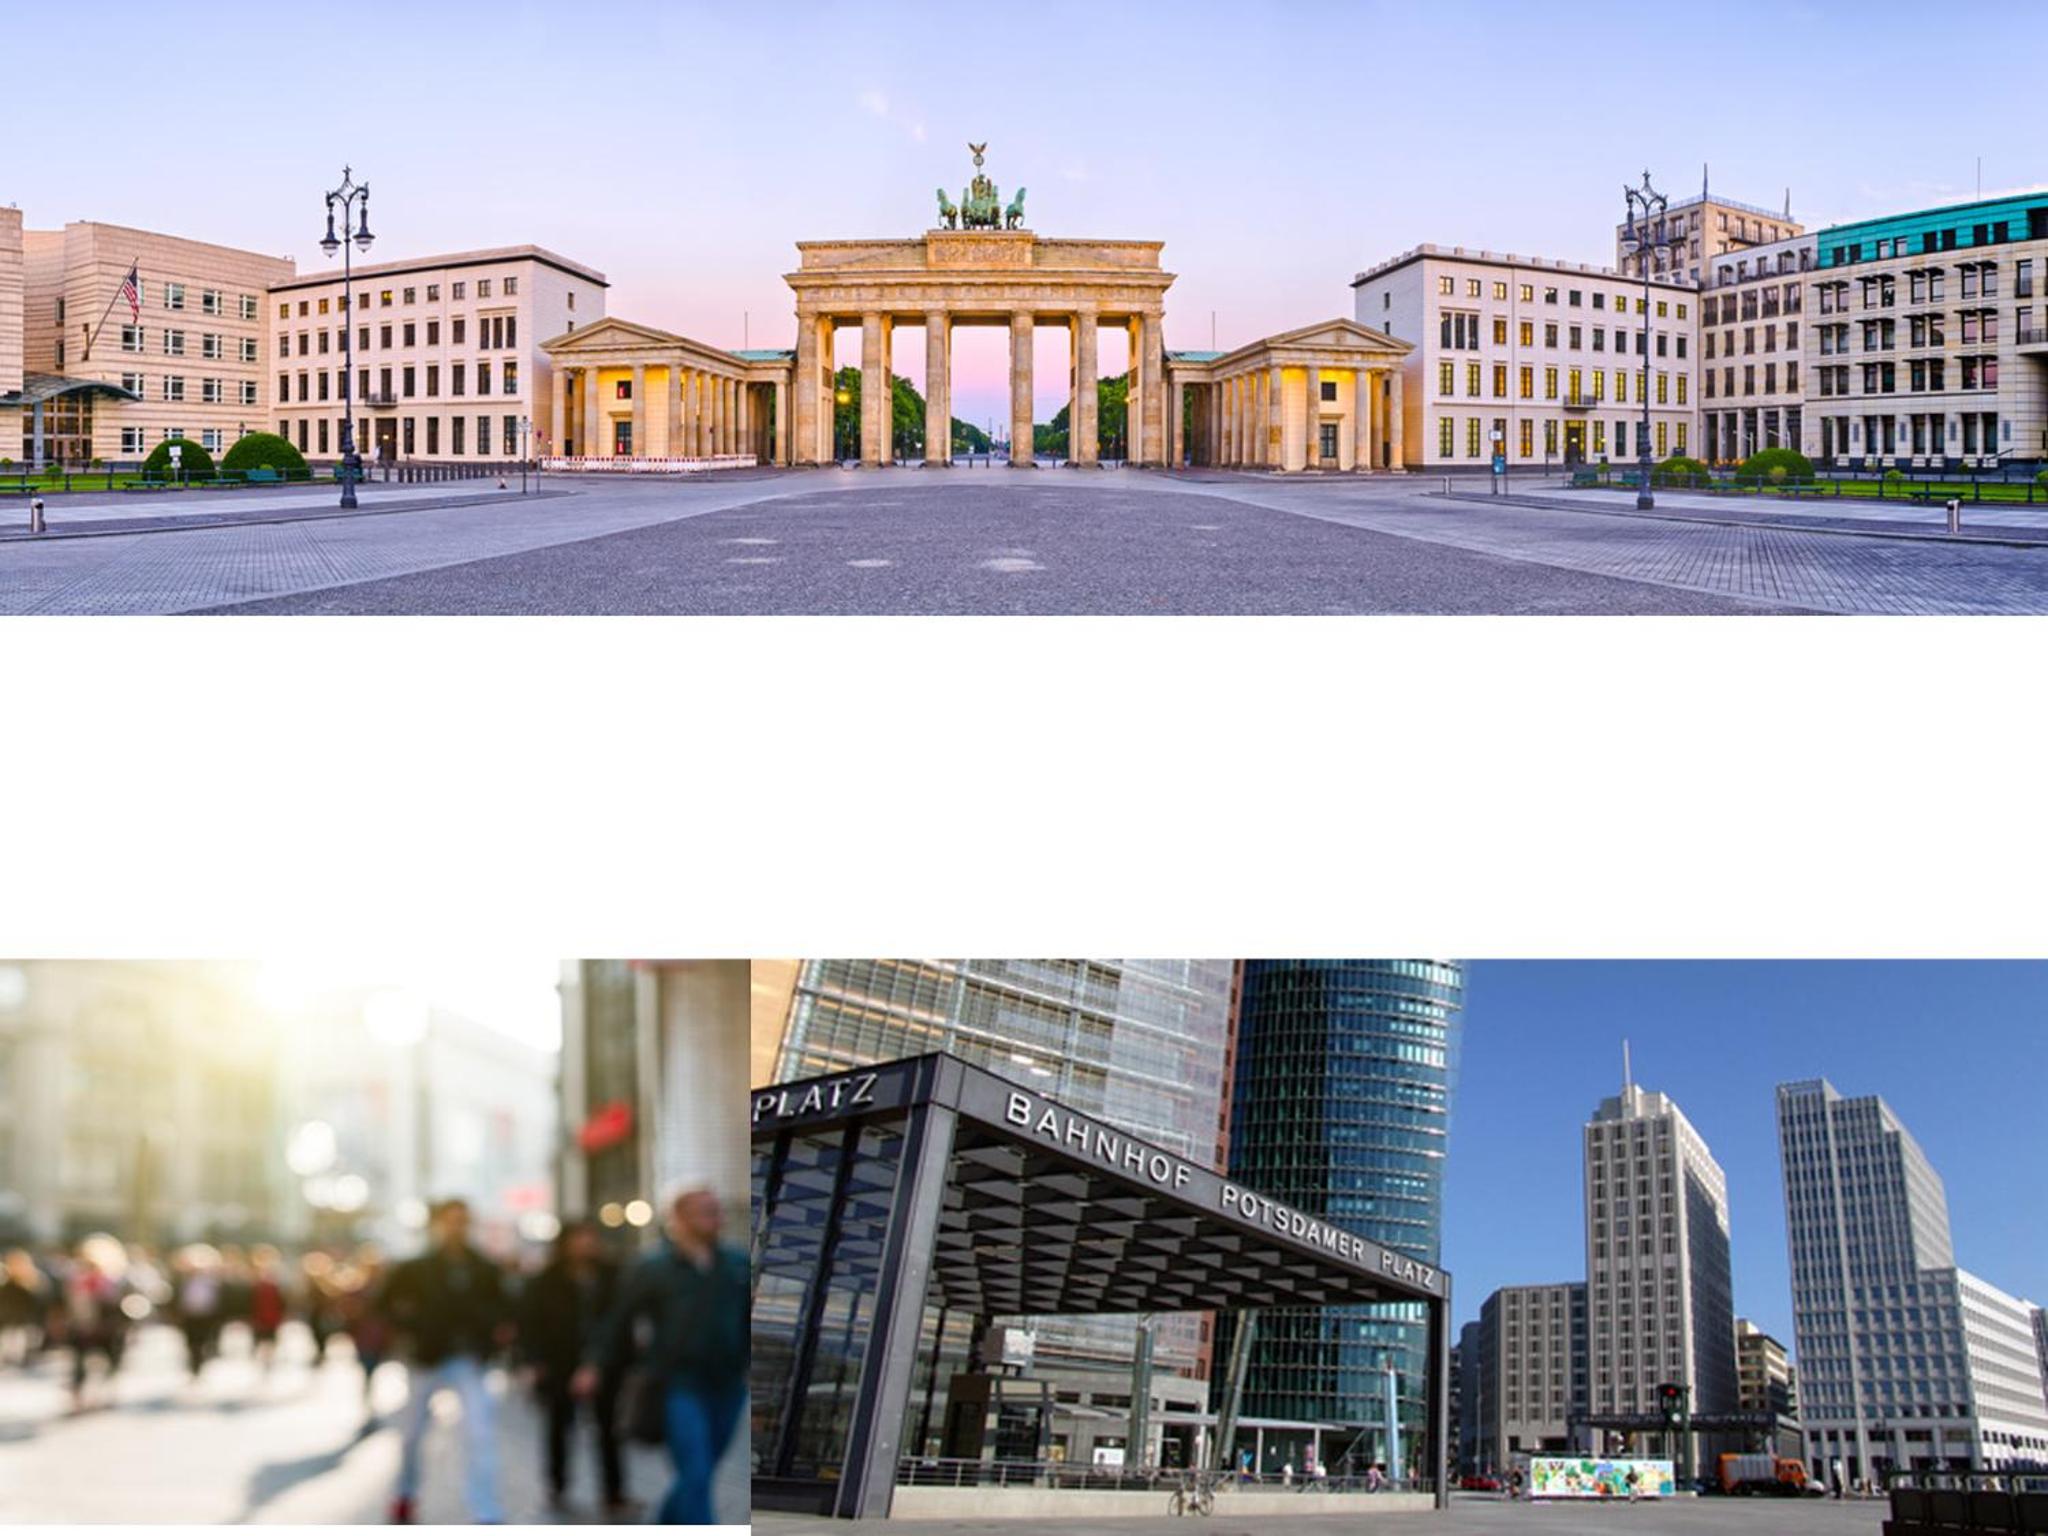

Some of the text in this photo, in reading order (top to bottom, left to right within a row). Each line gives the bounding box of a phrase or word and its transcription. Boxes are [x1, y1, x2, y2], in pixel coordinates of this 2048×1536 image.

[753, 1073, 878, 1122] PLATZ
[1005, 1093, 1435, 1289] BAHNHOF POTSDAMER PLATZ
